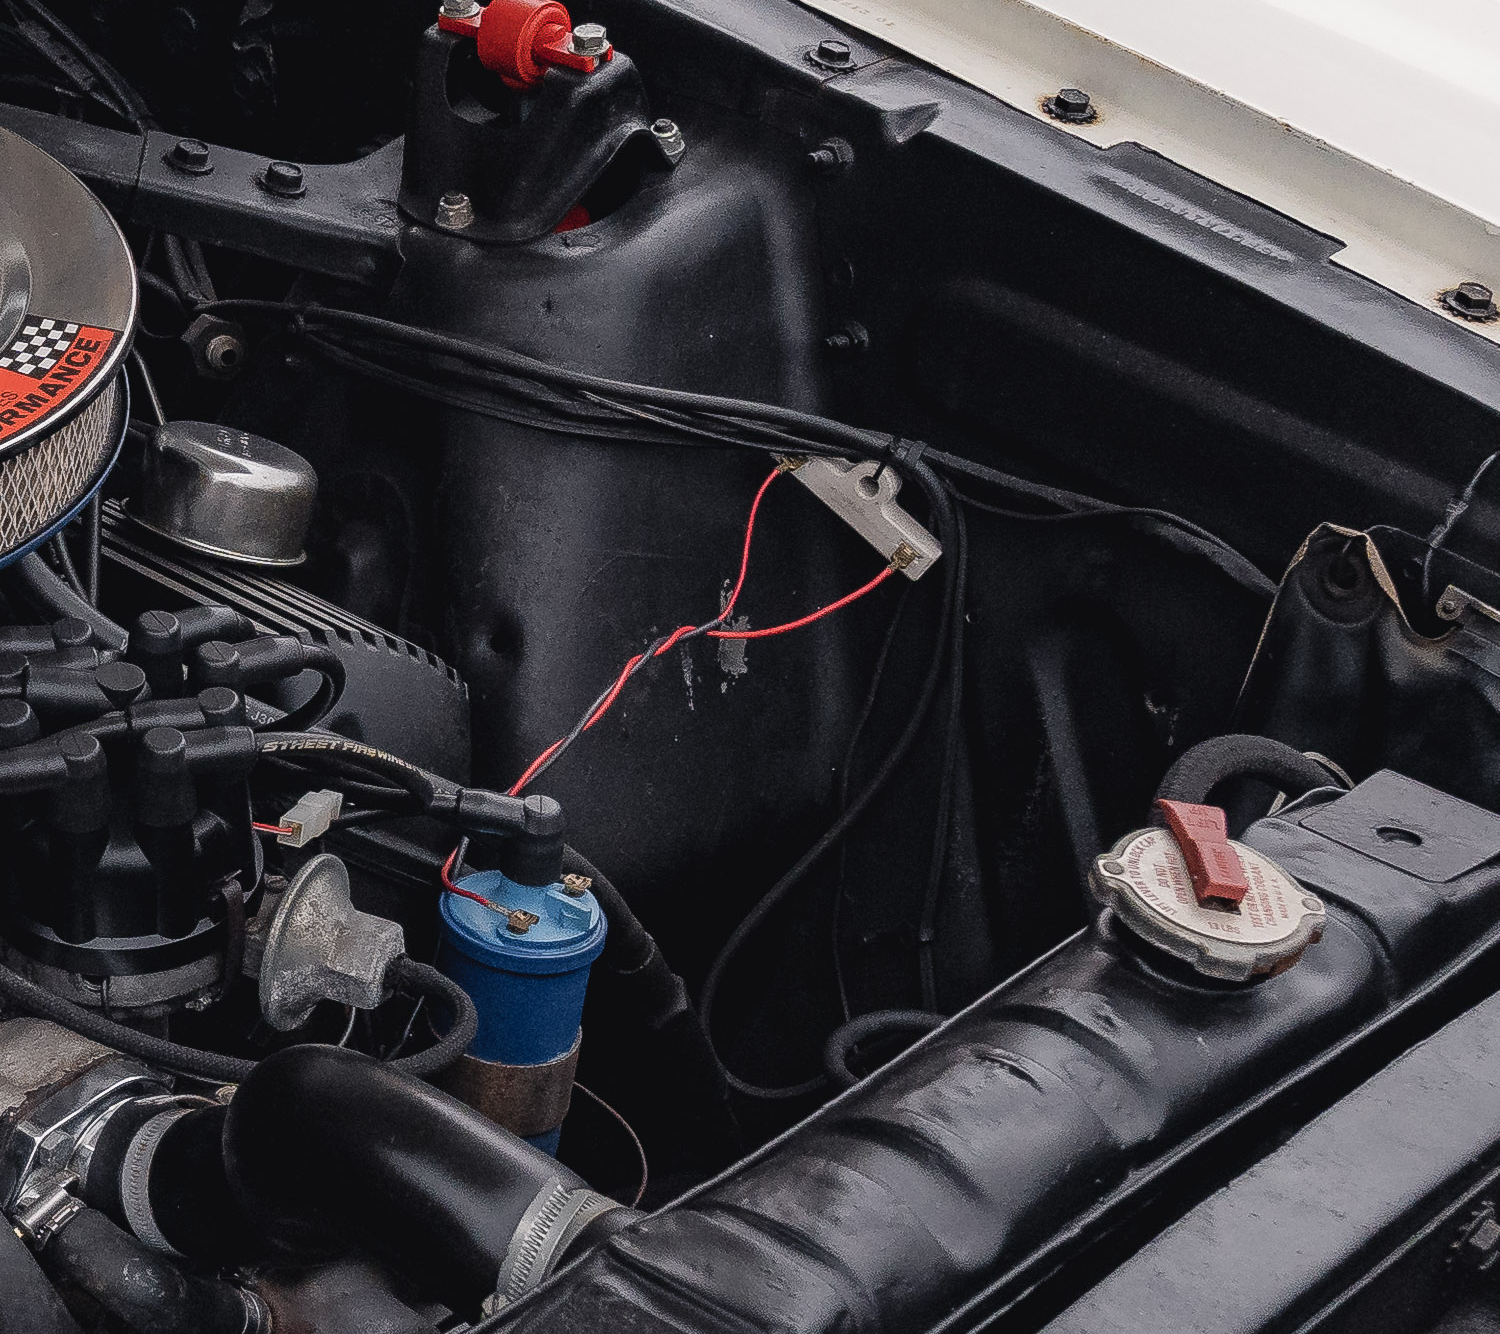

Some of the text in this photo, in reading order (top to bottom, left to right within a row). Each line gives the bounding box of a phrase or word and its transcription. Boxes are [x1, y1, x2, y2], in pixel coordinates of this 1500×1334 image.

[262, 740, 341, 753] STREET
[1129, 869, 1141, 879] TO
[1133, 880, 1160, 902] LEVER
